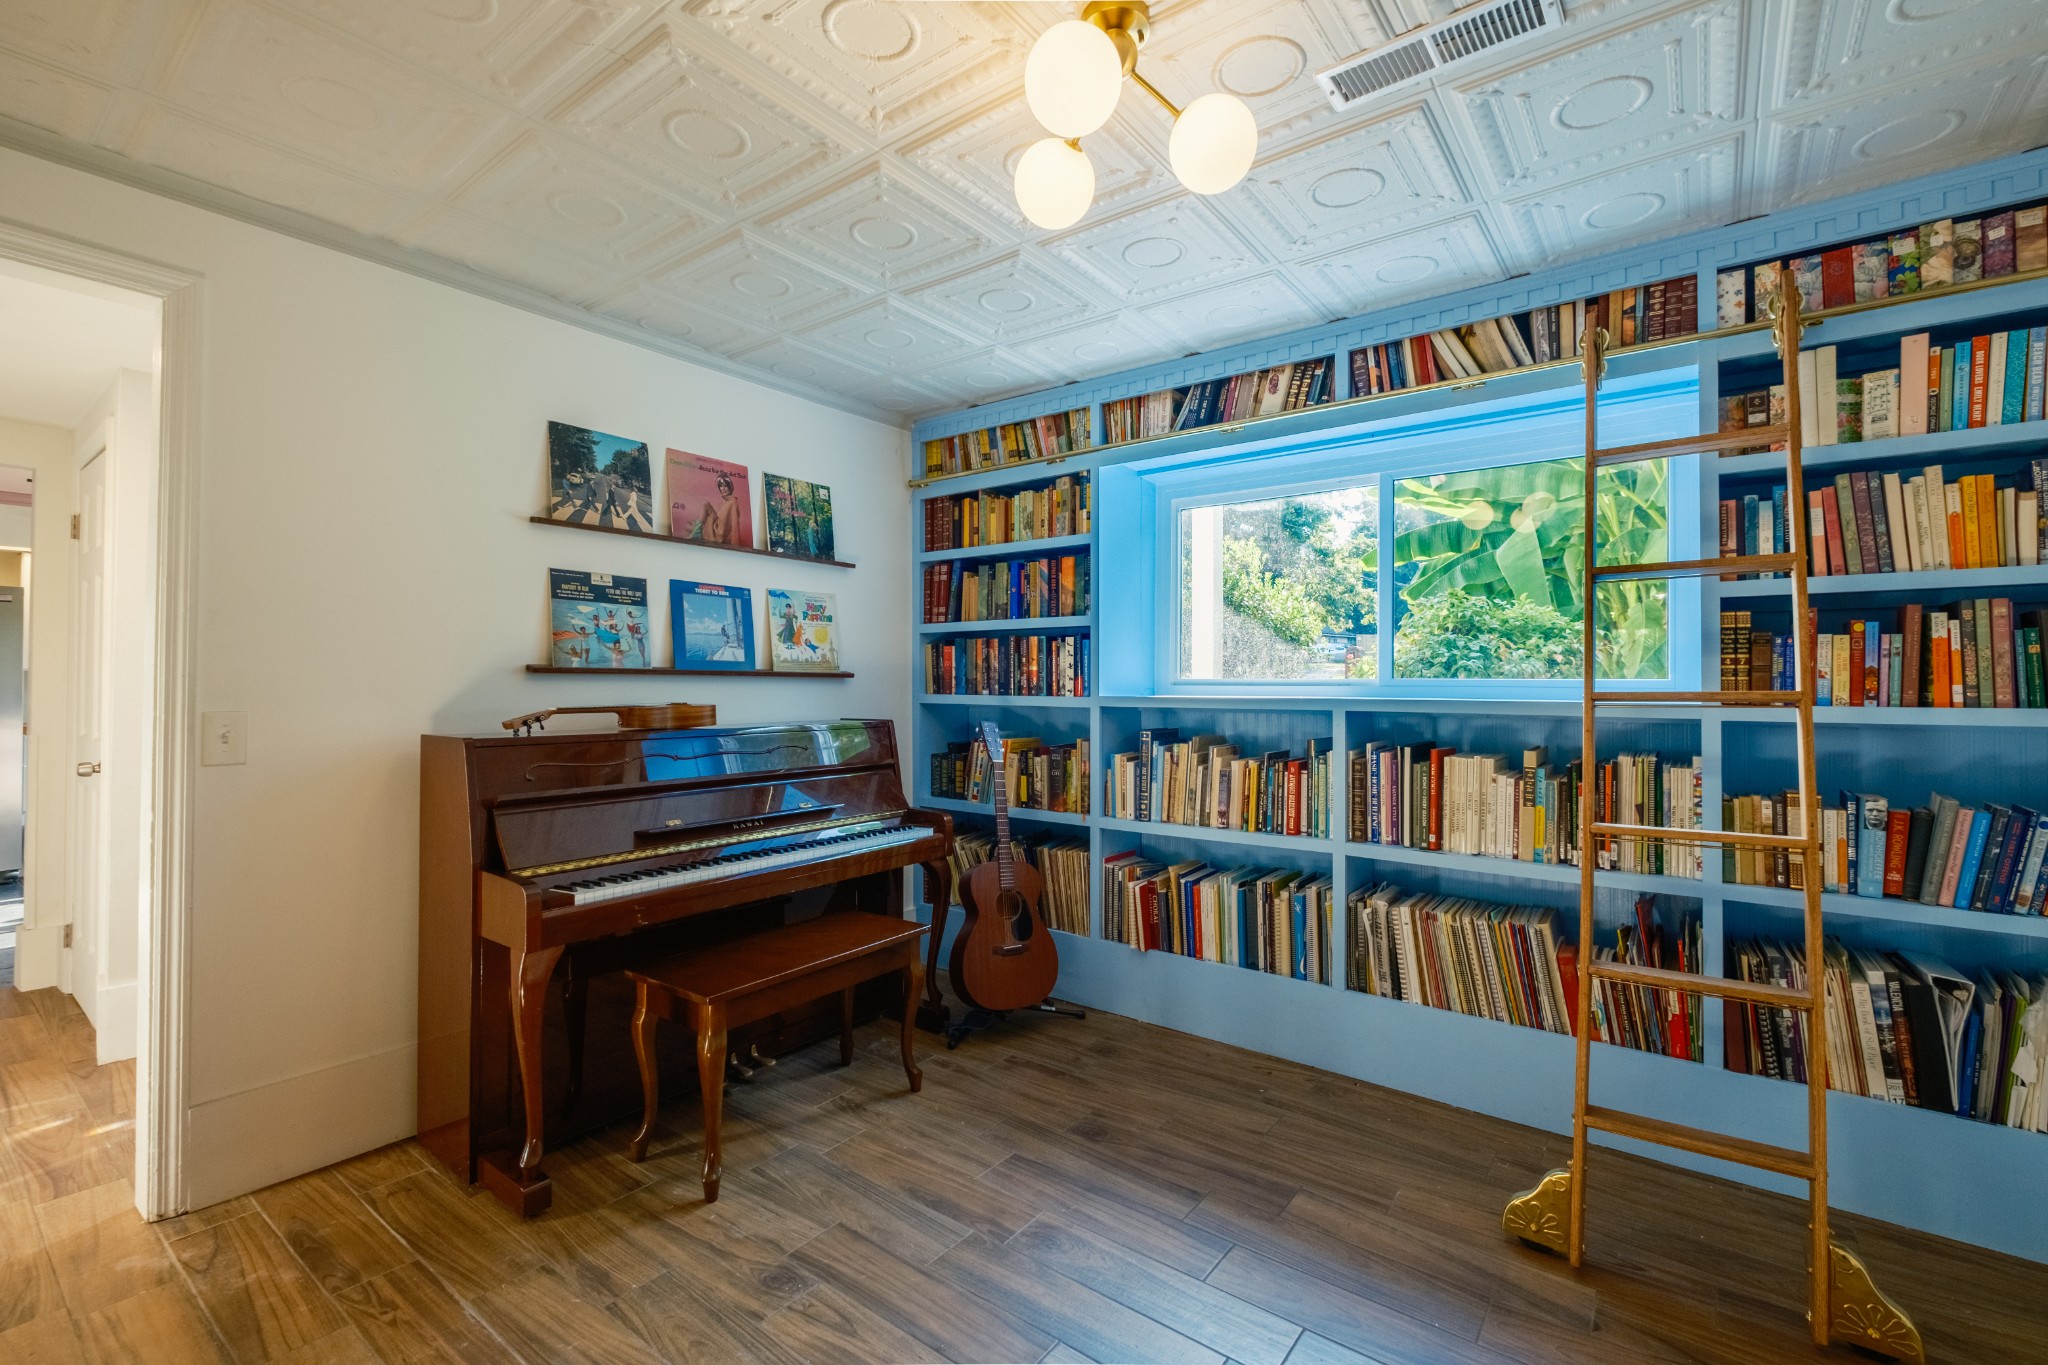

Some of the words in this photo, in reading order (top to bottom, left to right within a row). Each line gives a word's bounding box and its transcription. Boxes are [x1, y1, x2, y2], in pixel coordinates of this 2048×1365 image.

[1976, 350, 1985, 364] BOOK
[2032, 342, 2043, 365] BEACH
[1974, 366, 1984, 384] LOVERS
[2032, 367, 2042, 384] READ
[1973, 386, 1983, 403] EMILY
[2032, 386, 2040, 400] EMILY
[1972, 404, 1982, 421] HENRY
[1848, 801, 1856, 814] LOVE
[733, 820, 764, 830] KAWAI
[1894, 820, 1905, 831] J.K.
[1979, 819, 1987, 832] SOUL
[1890, 834, 1904, 868] ROWLING
[1974, 833, 1984, 857] SURVIVOR
[2005, 840, 2017, 857] FIRST
[1874, 831, 1884, 880] BONHOEFFER
[1999, 859, 2012, 884] OFFENSE
[1374, 920, 1382, 941] JAZZ
[1856, 986, 1867, 998] The
[1888, 981, 1904, 1012] VALENCIA
[1858, 999, 1868, 1009] Big
[1860, 1010, 1870, 1026] Book
[1866, 1037, 1876, 1051] Staff
[1868, 1052, 1878, 1070] Paper
